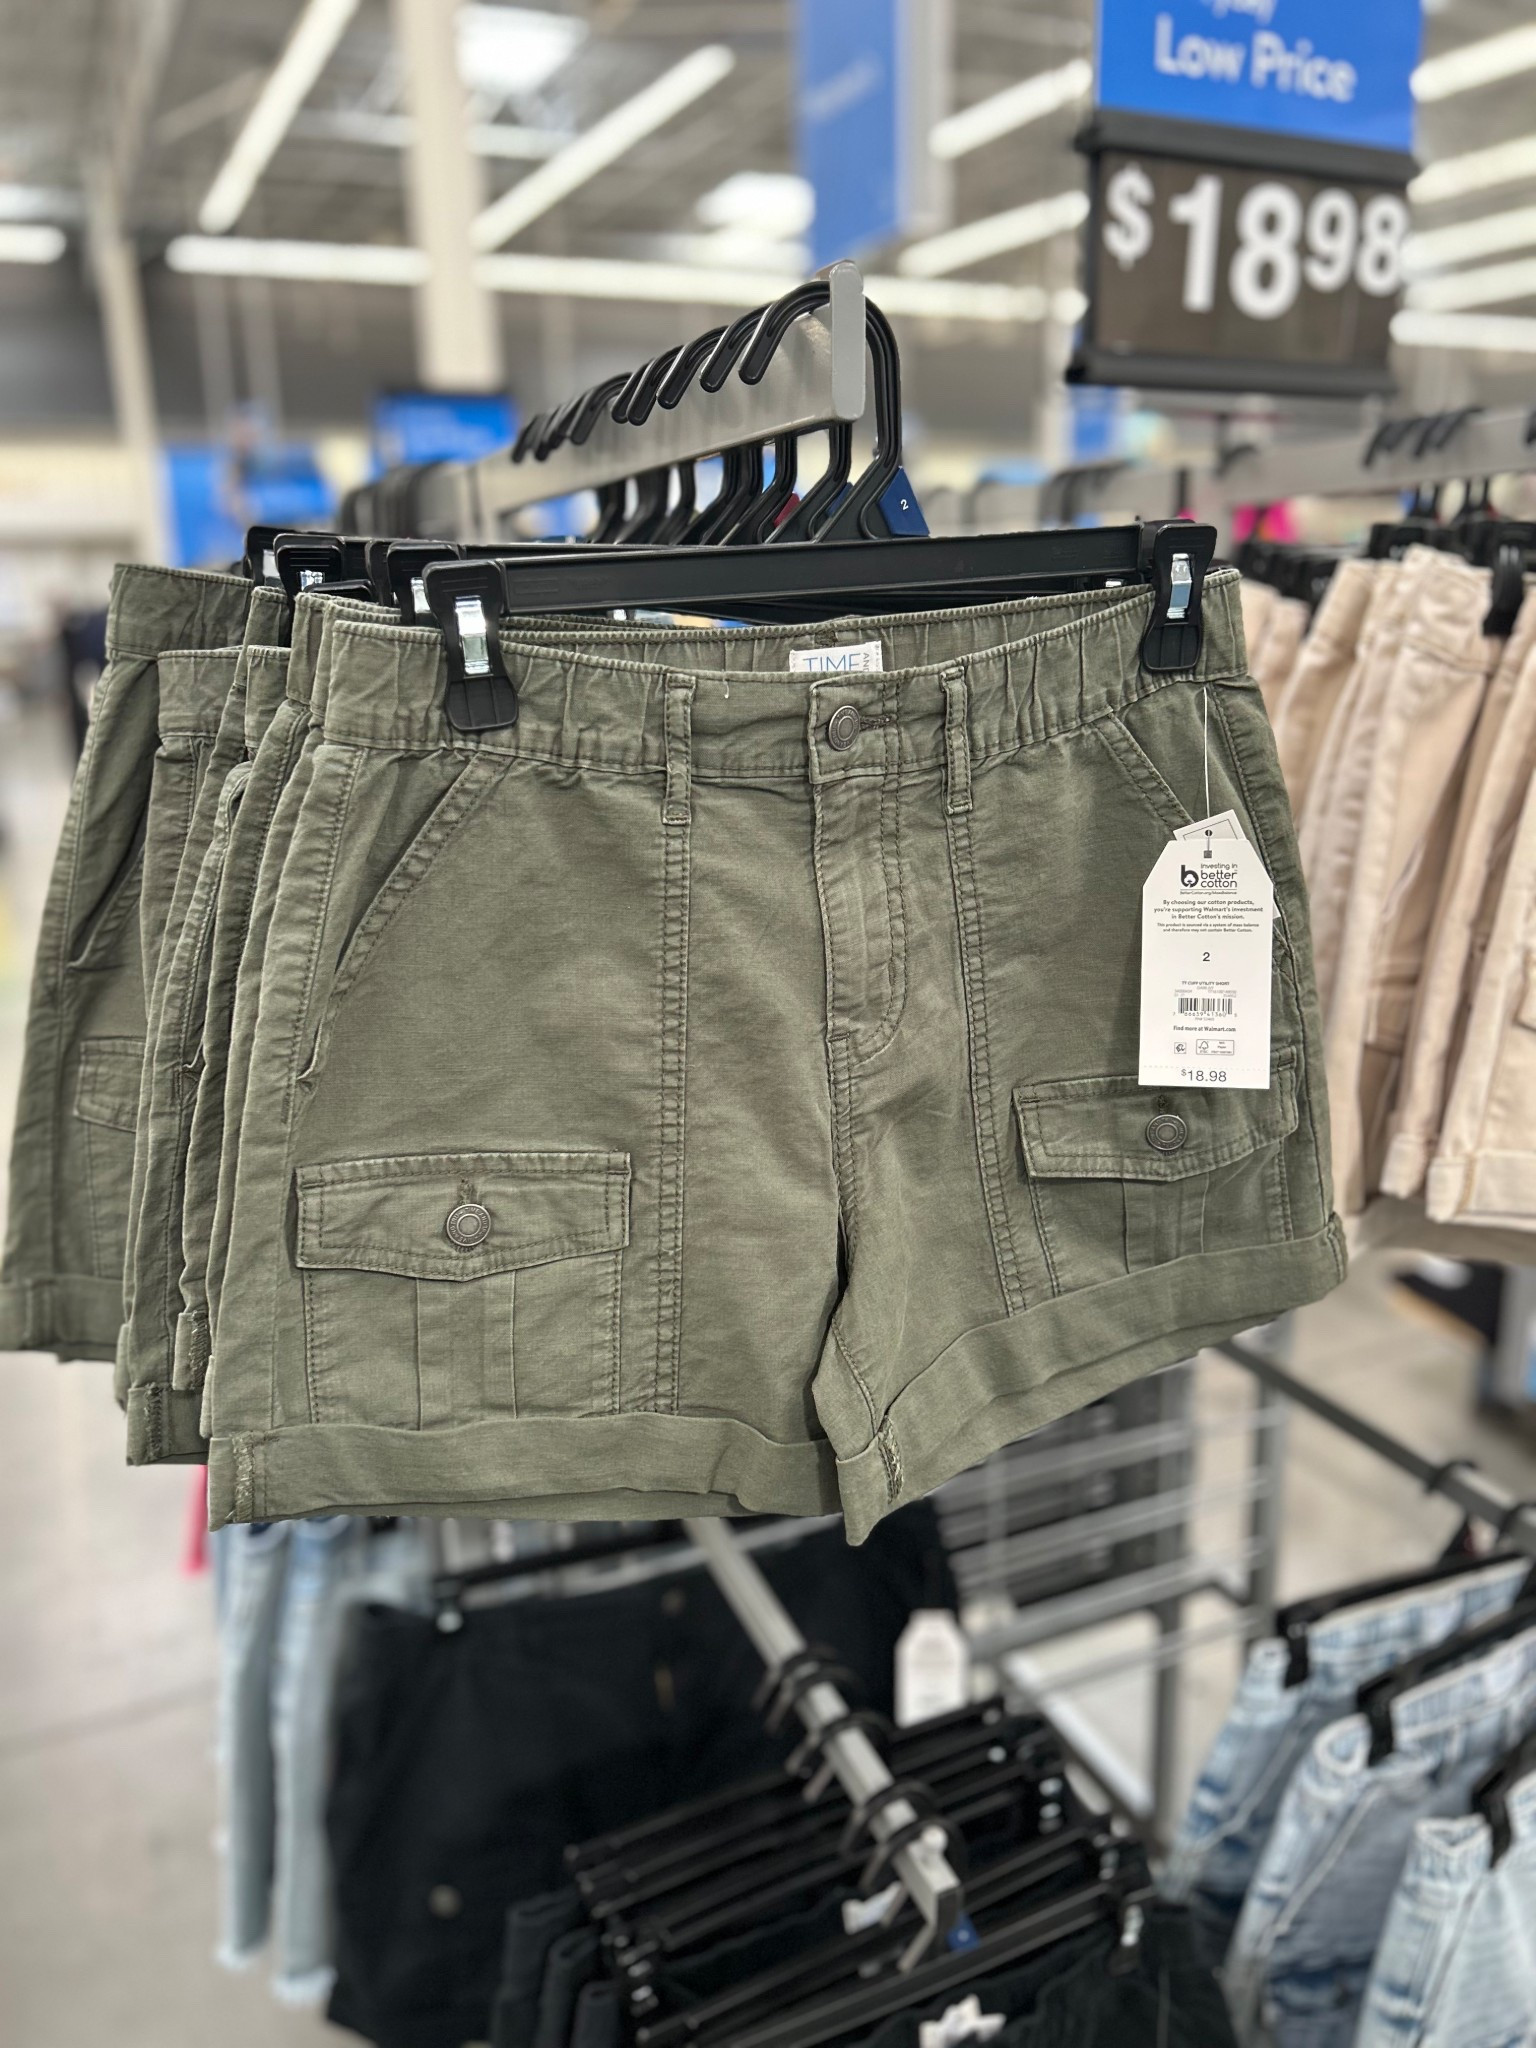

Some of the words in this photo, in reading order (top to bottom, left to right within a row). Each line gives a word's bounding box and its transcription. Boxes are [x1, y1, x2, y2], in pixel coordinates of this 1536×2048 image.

[1153, 12, 1246, 83] Low
[1251, 30, 1358, 102] Price
[900, 498, 909, 511] 2
[802, 652, 861, 671] TIME
[1200, 870, 1238, 880] better
[1200, 878, 1238, 888] cotton
[1202, 952, 1210, 962] 2
[1181, 1068, 1227, 1082] $18.98
